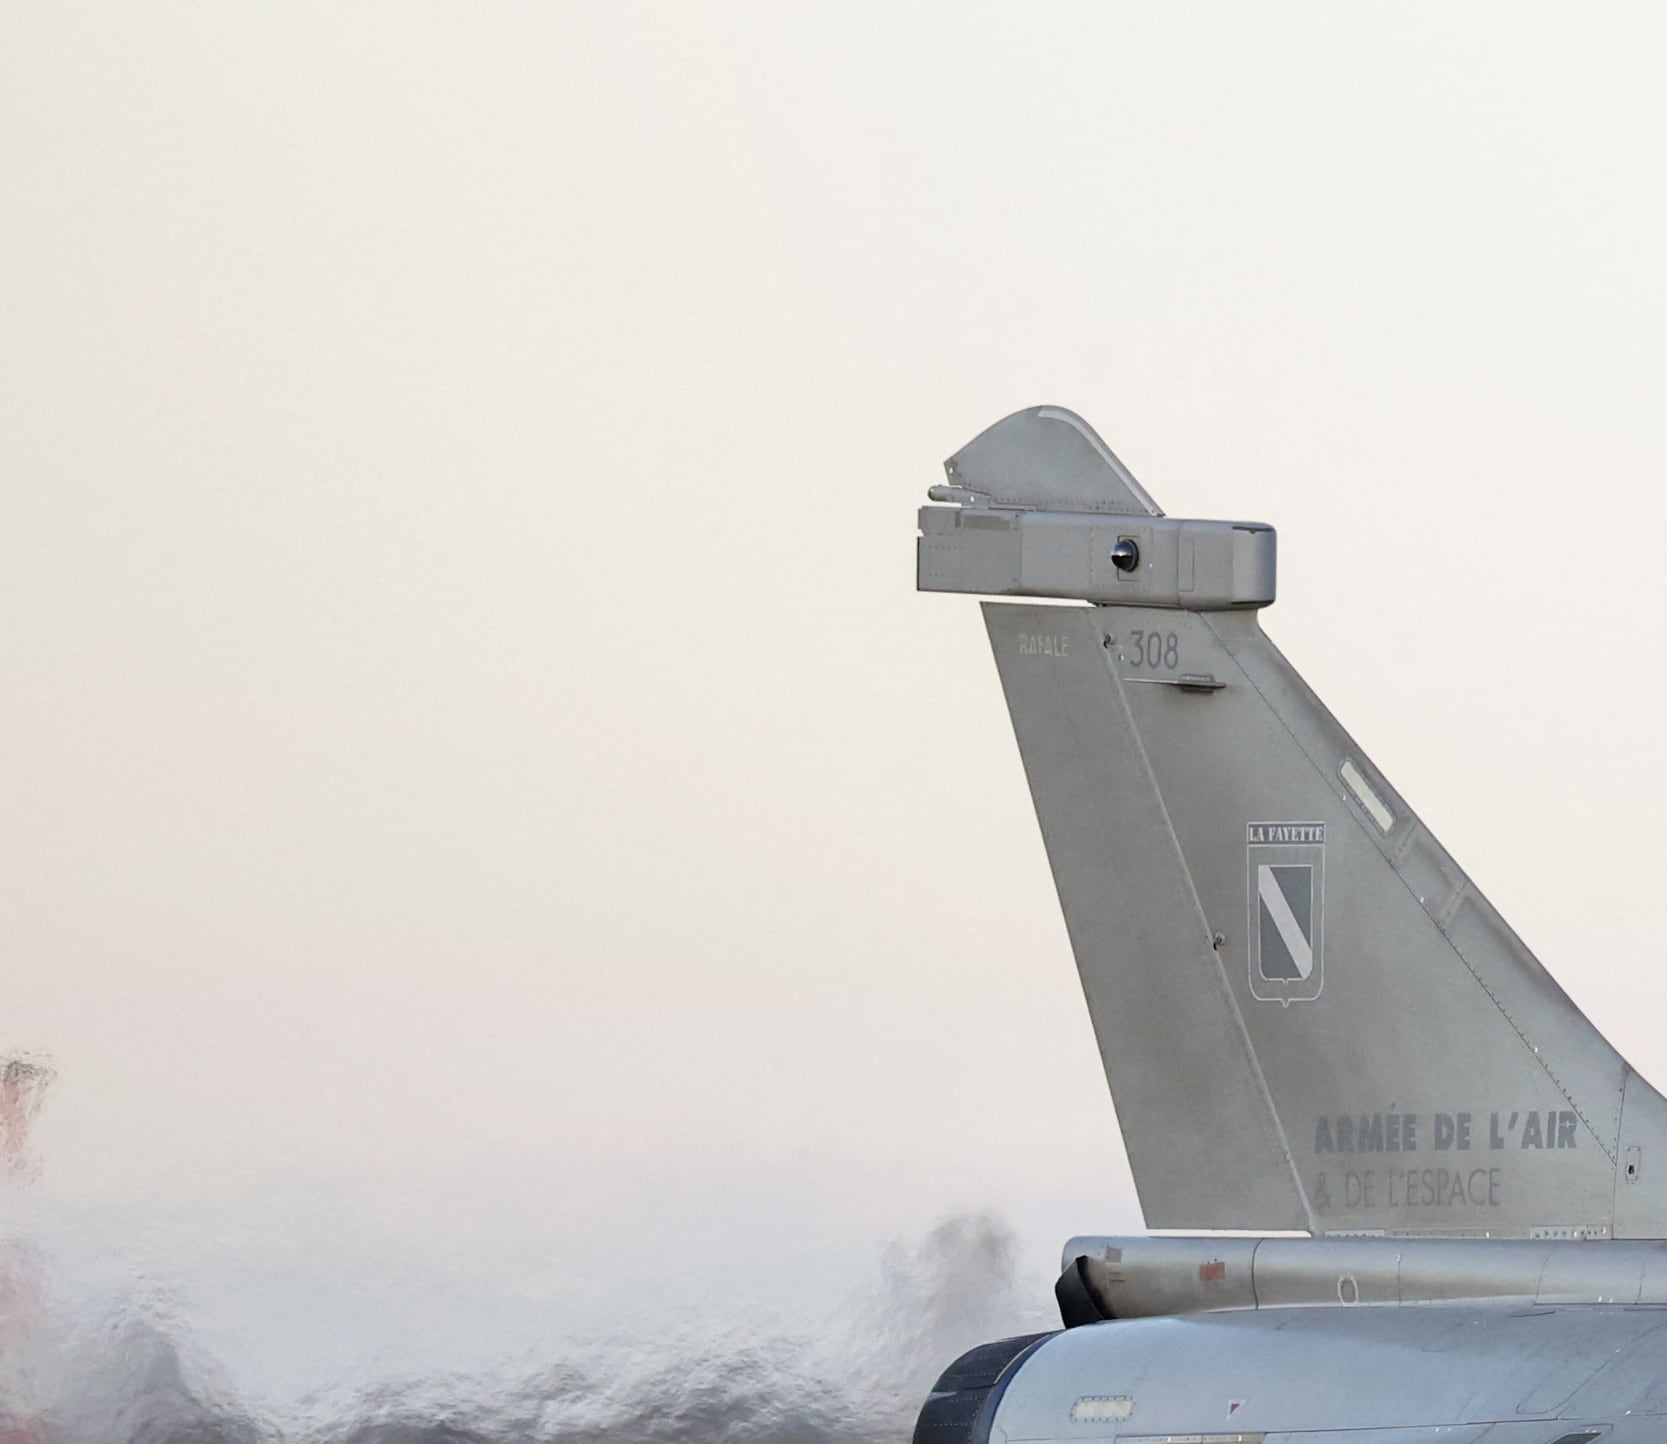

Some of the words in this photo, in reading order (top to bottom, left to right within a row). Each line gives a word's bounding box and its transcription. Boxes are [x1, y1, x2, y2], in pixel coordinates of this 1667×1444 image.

[1130, 630, 1179, 669] 308
[1249, 827, 1264, 842] LA
[1268, 826, 1323, 841] FAYETTE
[1314, 1103, 1417, 1152] ARMÉE
[1434, 1112, 1471, 1150] DE
[1489, 1111, 1578, 1149] L'AIR
[1314, 1172, 1331, 1209] &
[1346, 1170, 1376, 1208] DE
[1389, 1168, 1501, 1207] L'ESPACE
